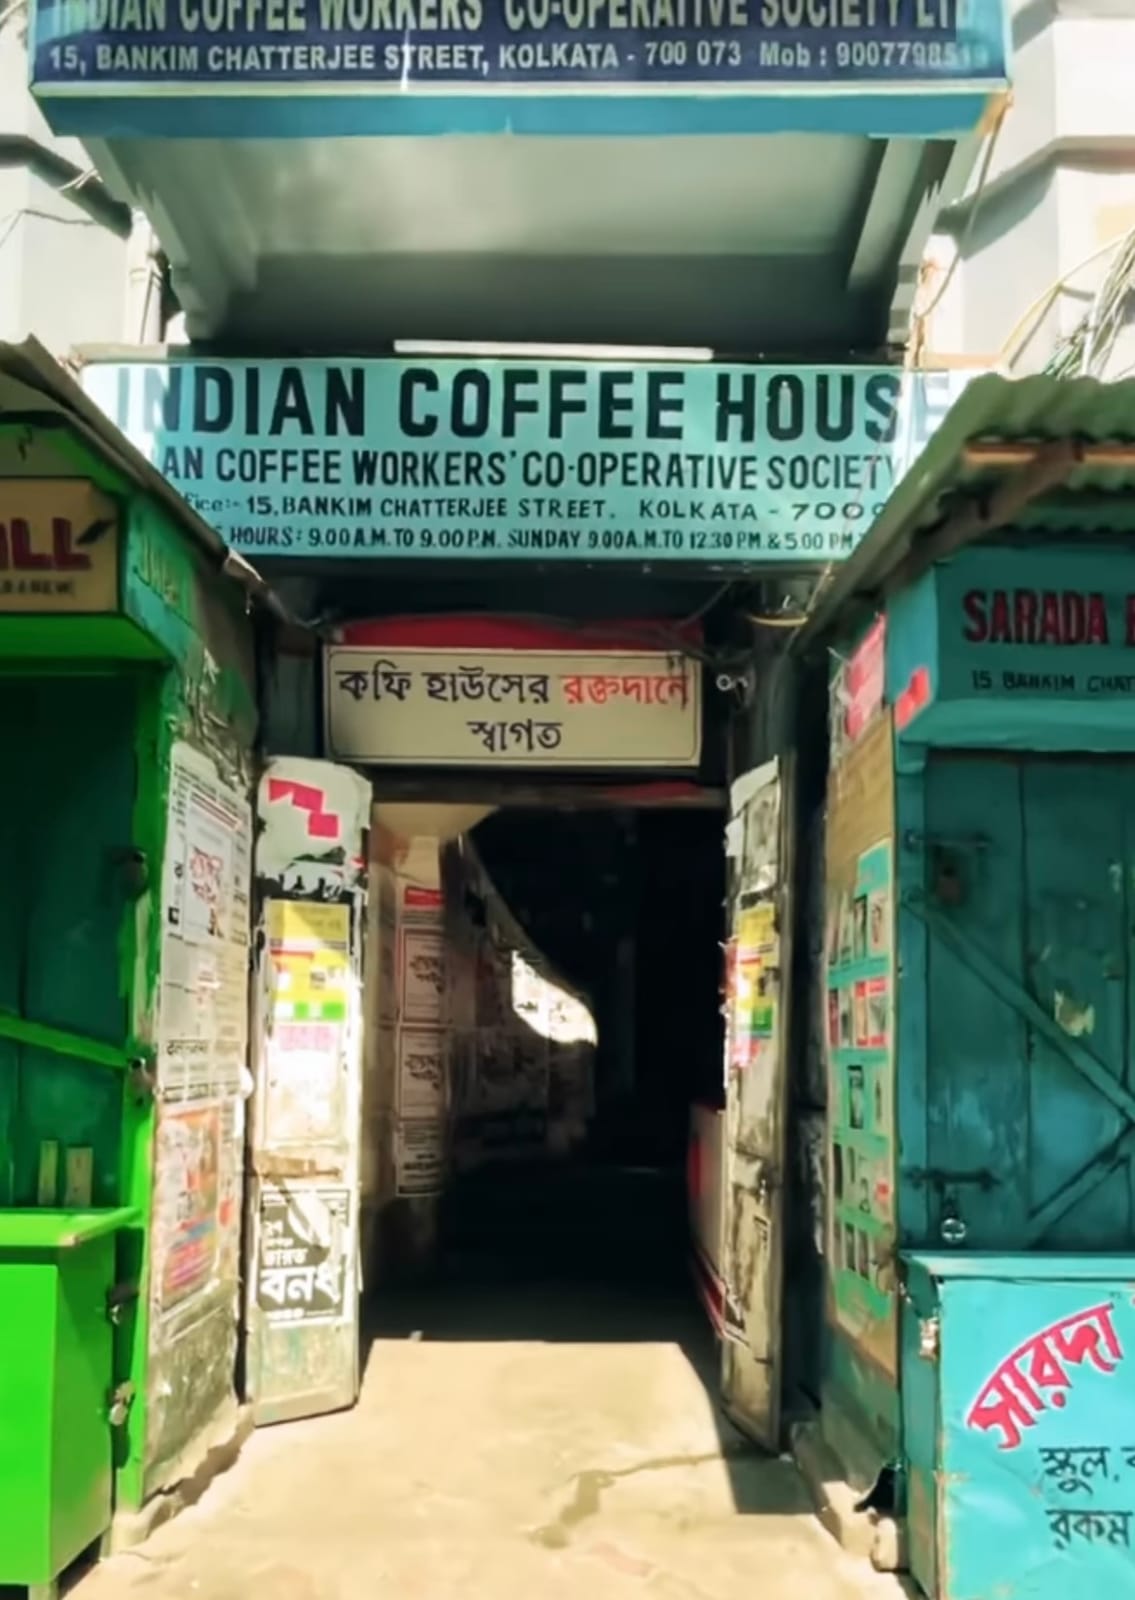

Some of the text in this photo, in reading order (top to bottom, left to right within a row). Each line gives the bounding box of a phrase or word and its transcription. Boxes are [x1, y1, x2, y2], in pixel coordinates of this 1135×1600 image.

[180, 0, 307, 31] COFFEE
[504, 0, 748, 31] CO-OPERATIVE
[760, 0, 901, 29] SOCIETY
[49, 45, 87, 76] 15,
[96, 45, 199, 71] BANKIM
[207, 45, 376, 71] CHATTERJEE
[384, 43, 490, 76] STREET,
[500, 43, 618, 69] KOLKATA
[645, 41, 687, 66] 700
[697, 41, 742, 66] 073
[760, 42, 810, 67] Mob
[115, 366, 950, 443] INDIAN COFFEE HOUSE
[216, 448, 342, 484] COFFEE
[353, 450, 516, 487] WORKERS'
[522, 451, 757, 490] CO-OPERATIVE
[282, 496, 372, 518] BANKIM
[380, 497, 508, 518] CHATTERJEE
[639, 500, 758, 521] KOLKATA
[507, 530, 581, 548] SUNDAY
[961, 588, 1110, 646] SARADA
[336, 659, 411, 702] কফি
[422, 665, 549, 704] হাউসের
[972, 669, 993, 690] 15
[1003, 671, 1075, 692] BANKIM
[467, 717, 563, 753] স্বাগত
[966, 1300, 1124, 1450] সারদা
[1045, 1509, 1134, 1551] রকম
